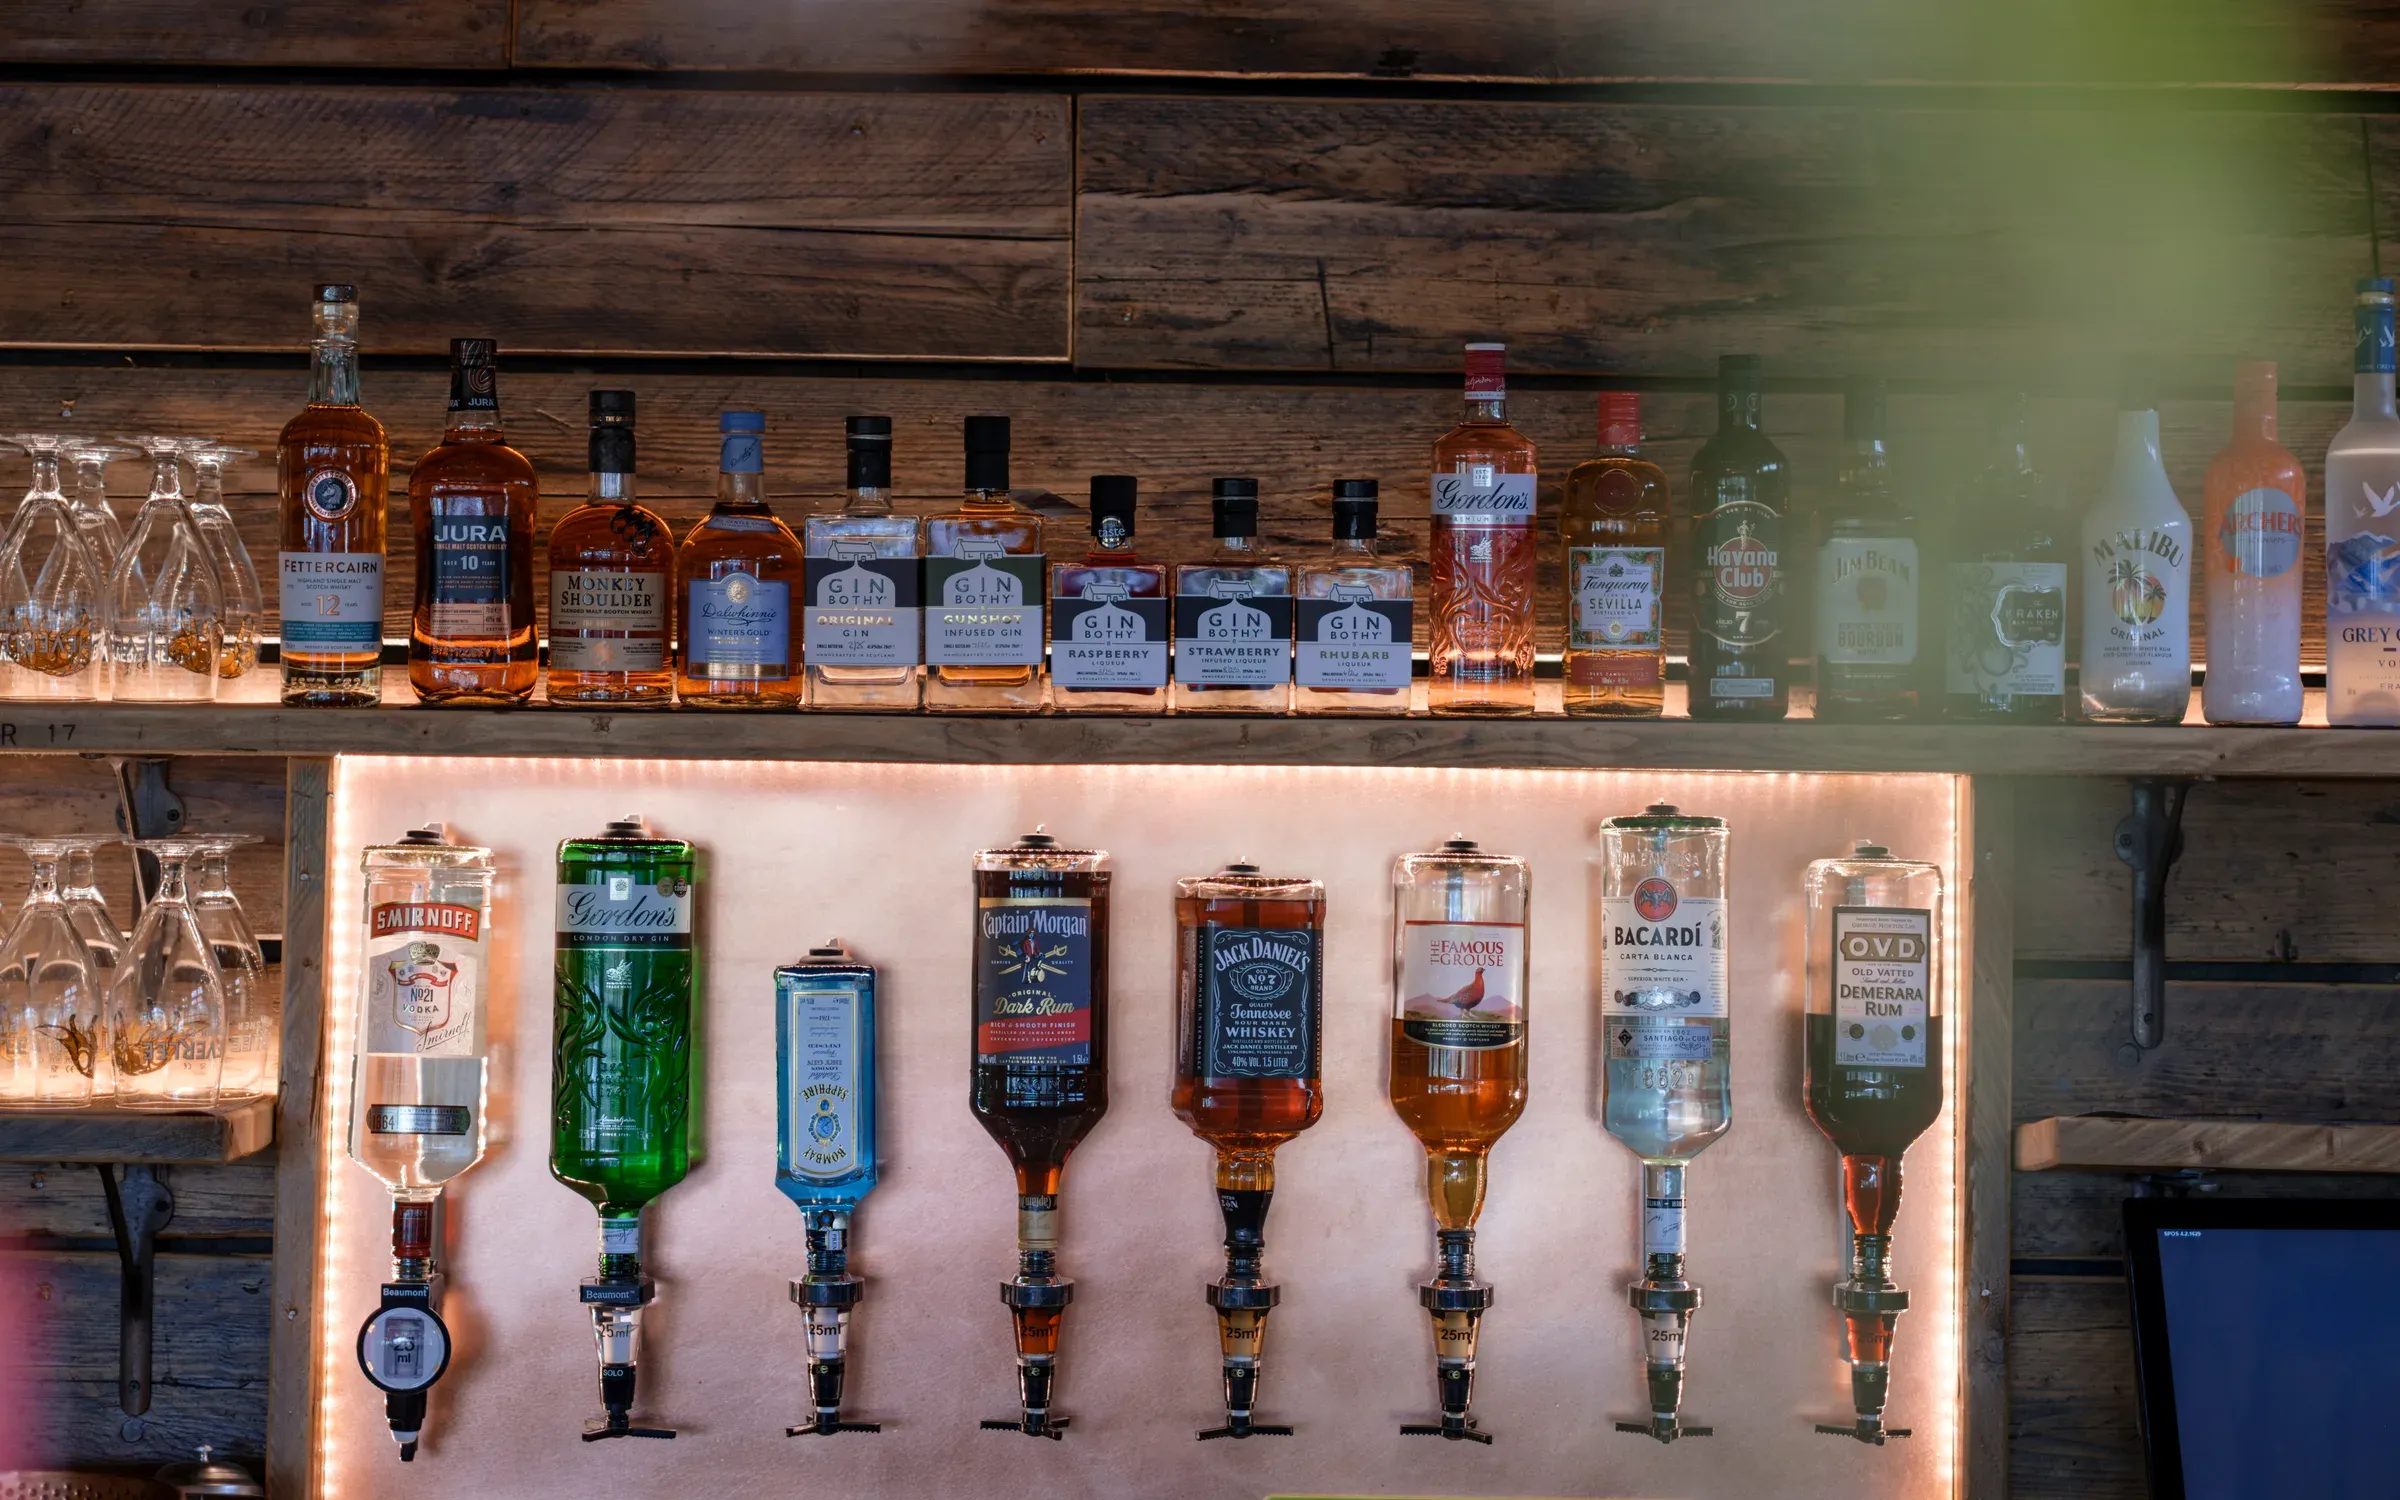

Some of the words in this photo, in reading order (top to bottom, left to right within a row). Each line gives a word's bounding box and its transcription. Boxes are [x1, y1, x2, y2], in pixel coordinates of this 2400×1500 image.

[468, 398, 494, 406] JURA
[1437, 479, 1528, 510] Gordon's
[434, 525, 506, 542] JURA
[1098, 528, 1125, 537] taste
[2093, 529, 2184, 567] MALIBU
[1707, 545, 1777, 566] Havana
[285, 560, 377, 573] FETTERCAIRN
[1832, 556, 1863, 584] JIM
[568, 576, 645, 591] MONKEY
[1721, 566, 1764, 587] Club
[829, 579, 884, 593] GIN
[955, 577, 1011, 592] GIN
[1584, 576, 1649, 593] Tanqueray
[316, 594, 340, 616] 12
[561, 591, 651, 607] SHOULDER
[829, 596, 883, 604] BOTHY
[955, 595, 1010, 604] BOTHY
[1590, 599, 1642, 609] SEVILLA
[702, 602, 777, 618] Dalwhinnie
[2006, 609, 2058, 619] KRAKEN
[817, 615, 893, 625] ORIGINAL
[944, 615, 1022, 624] GUNSHOT
[1085, 616, 1133, 628] GIN
[1209, 613, 1260, 626] GIN
[1331, 617, 1379, 629] GIN
[1736, 611, 1751, 633] 7
[1209, 629, 1259, 637] BOTHY
[1331, 631, 1379, 639] BOTHY
[1838, 631, 1903, 647] BOURBON
[2343, 627, 2391, 642] GREY
[1069, 650, 1149, 658] RASPBERRY
[1189, 647, 1280, 656] STRAWBERRY
[1320, 651, 1389, 659] RHUBARB
[2378, 660, 2400, 668] VO
[1, 724, 16, 746] R
[48, 724, 76, 744] 17
[567, 891, 676, 927] Gordon's
[377, 907, 474, 931] SMIRNOFF
[983, 910, 1028, 939] Captain
[1030, 910, 1086, 938] Morgan
[1615, 922, 1702, 946] BACARDÍ
[1214, 943, 1250, 972] JACK
[1252, 937, 1310, 972] DANIEL'S
[1431, 940, 1440, 965] THE
[1441, 940, 1504, 954] FAMOUS
[1849, 937, 1918, 958] O.V.D.
[1440, 954, 1503, 967] GROUSE
[1268, 975, 1277, 984] 7
[1852, 968, 1873, 976] OLD
[1877, 969, 1914, 977] VATTED
[1011, 990, 1051, 998] ORIGINAL
[1840, 984, 1923, 1001] DEMERARA
[403, 1004, 439, 1014] VODKA
[993, 997, 1033, 1014] Dark
[1036, 997, 1074, 1016] Rum
[1230, 1004, 1292, 1019] Tennessee
[1865, 1001, 1903, 1016] RUM
[417, 1012, 471, 1052] Smirnoff
[1225, 1027, 1296, 1038] WHISKEY
[1232, 1056, 1247, 1066] 40%
[1249, 1057, 1261, 1067] VOL.
[1263, 1057, 1272, 1067] 1.5
[1273, 1058, 1288, 1067] LITER
[800, 1084, 849, 1103] SAPPHIRE
[803, 1146, 847, 1164] BOMBAY
[1026, 1195, 1051, 1209] Captain
[383, 1287, 427, 1297] Beaumont
[586, 1290, 630, 1298] Beaumont
[599, 1325, 614, 1337] 25
[616, 1325, 629, 1337] ml
[809, 1324, 841, 1335] 25ml
[1021, 1325, 1054, 1337] 25ml
[397, 1353, 411, 1363] ml
